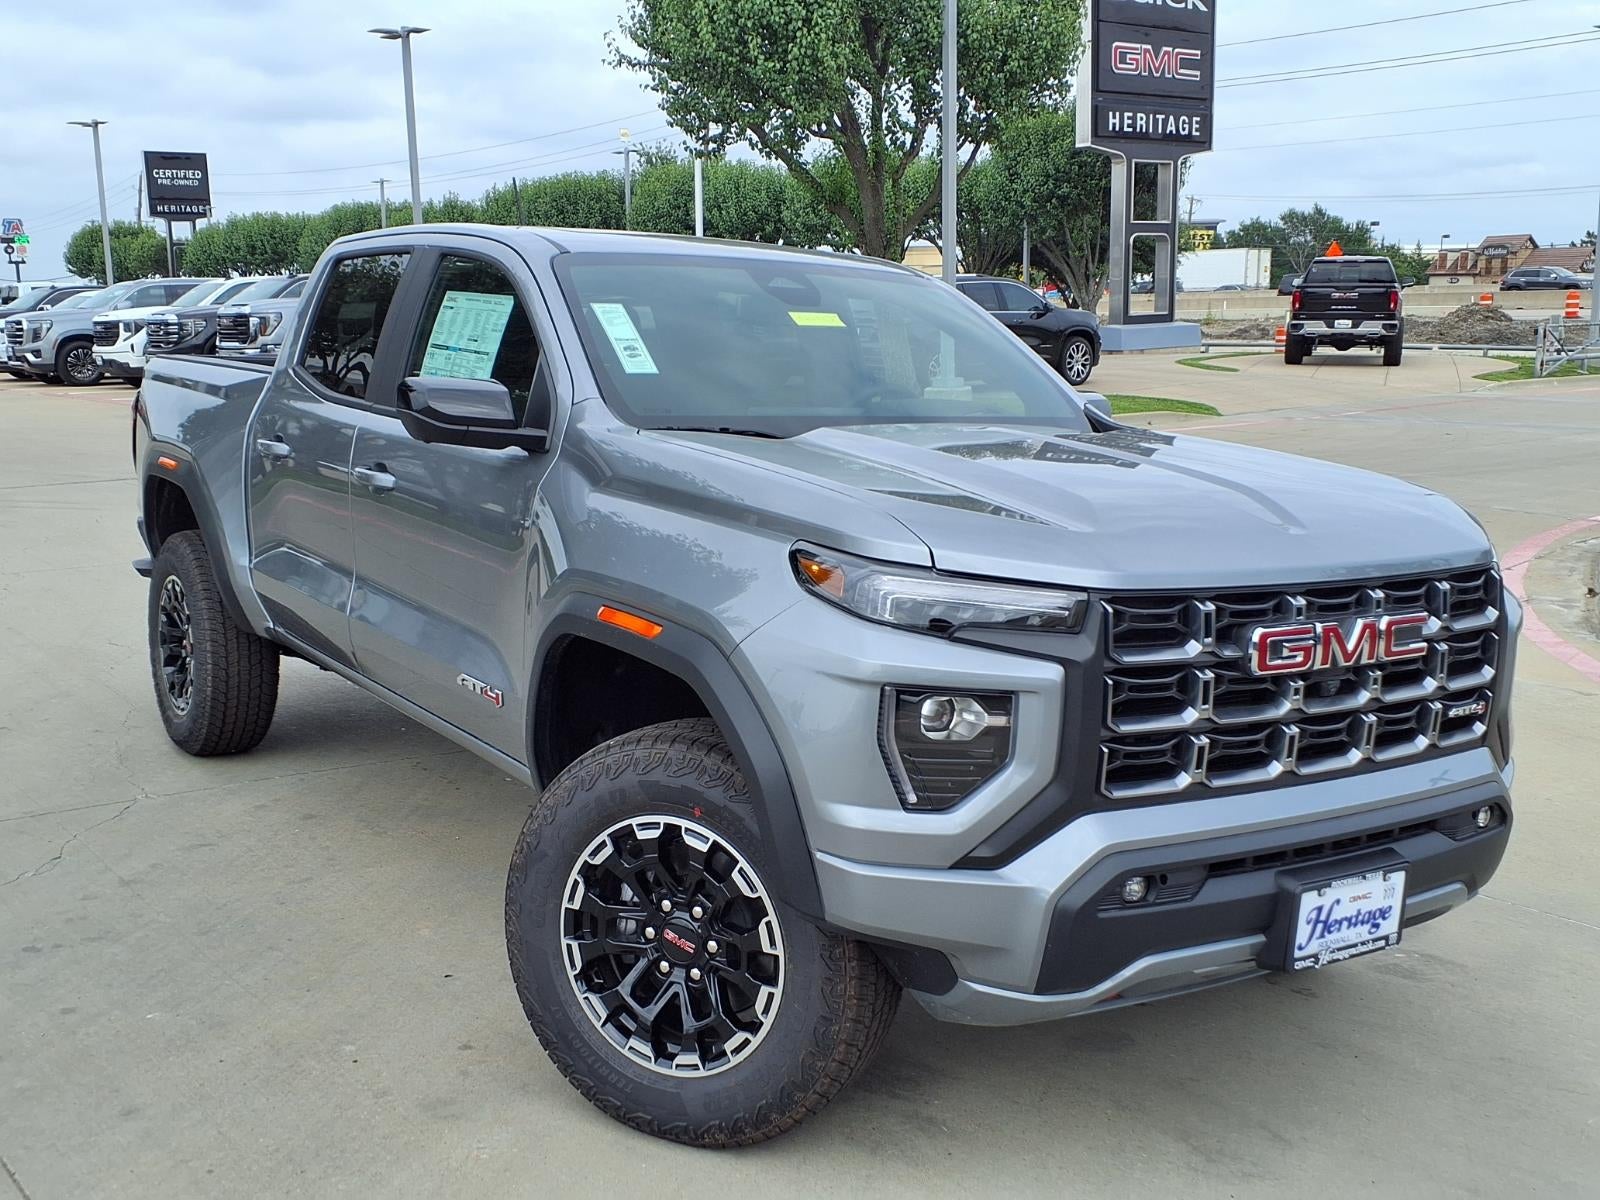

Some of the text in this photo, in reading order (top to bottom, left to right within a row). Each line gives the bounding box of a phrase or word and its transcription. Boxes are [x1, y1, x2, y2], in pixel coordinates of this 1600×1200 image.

[1111, 41, 1201, 81] GMC
[1108, 111, 1201, 136] HERITAGE
[152, 169, 202, 179] CERTIFIED
[157, 178, 199, 186] PRE-OWNED
[157, 204, 205, 213] HERITAGE
[1251, 611, 1429, 676] GMC
[456, 672, 504, 708] AT4
[1448, 701, 1487, 718] AT4
[1296, 897, 1393, 951] Heritage
[663, 928, 696, 954] GMC
